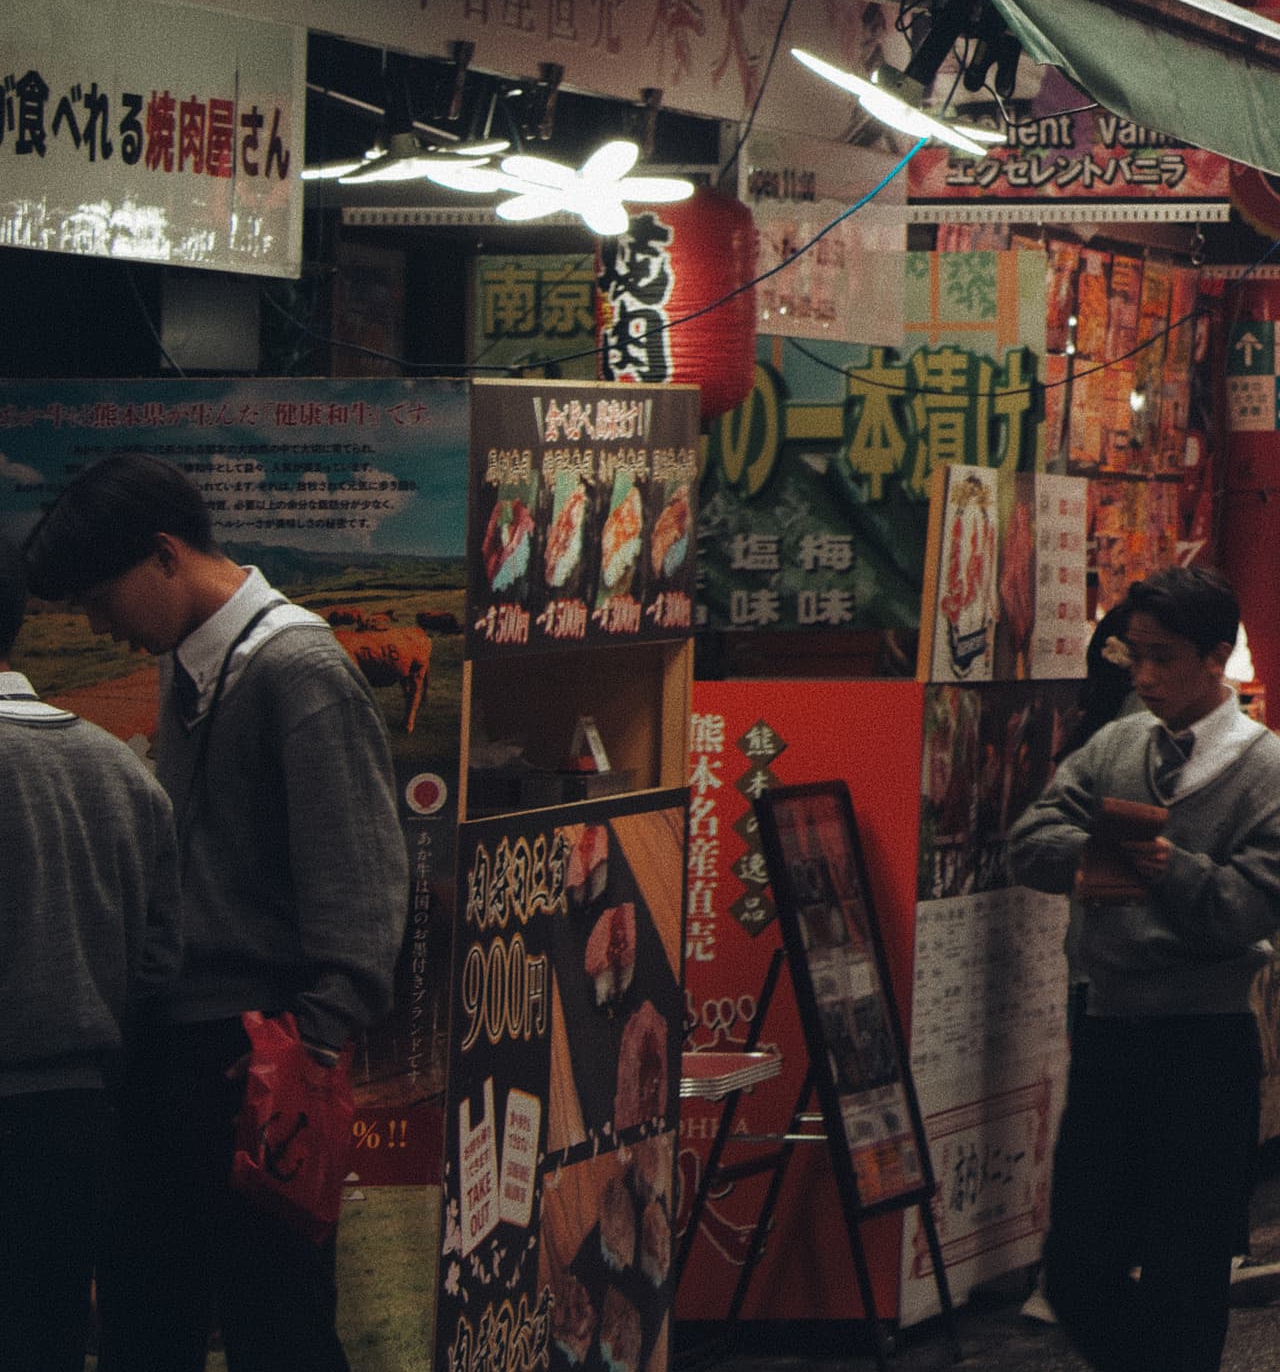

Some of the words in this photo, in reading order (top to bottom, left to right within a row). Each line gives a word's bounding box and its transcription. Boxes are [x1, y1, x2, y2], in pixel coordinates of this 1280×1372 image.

[947, 158, 1187, 190] エクセレントバニラ
[698, 347, 1029, 498] の一本漬け
